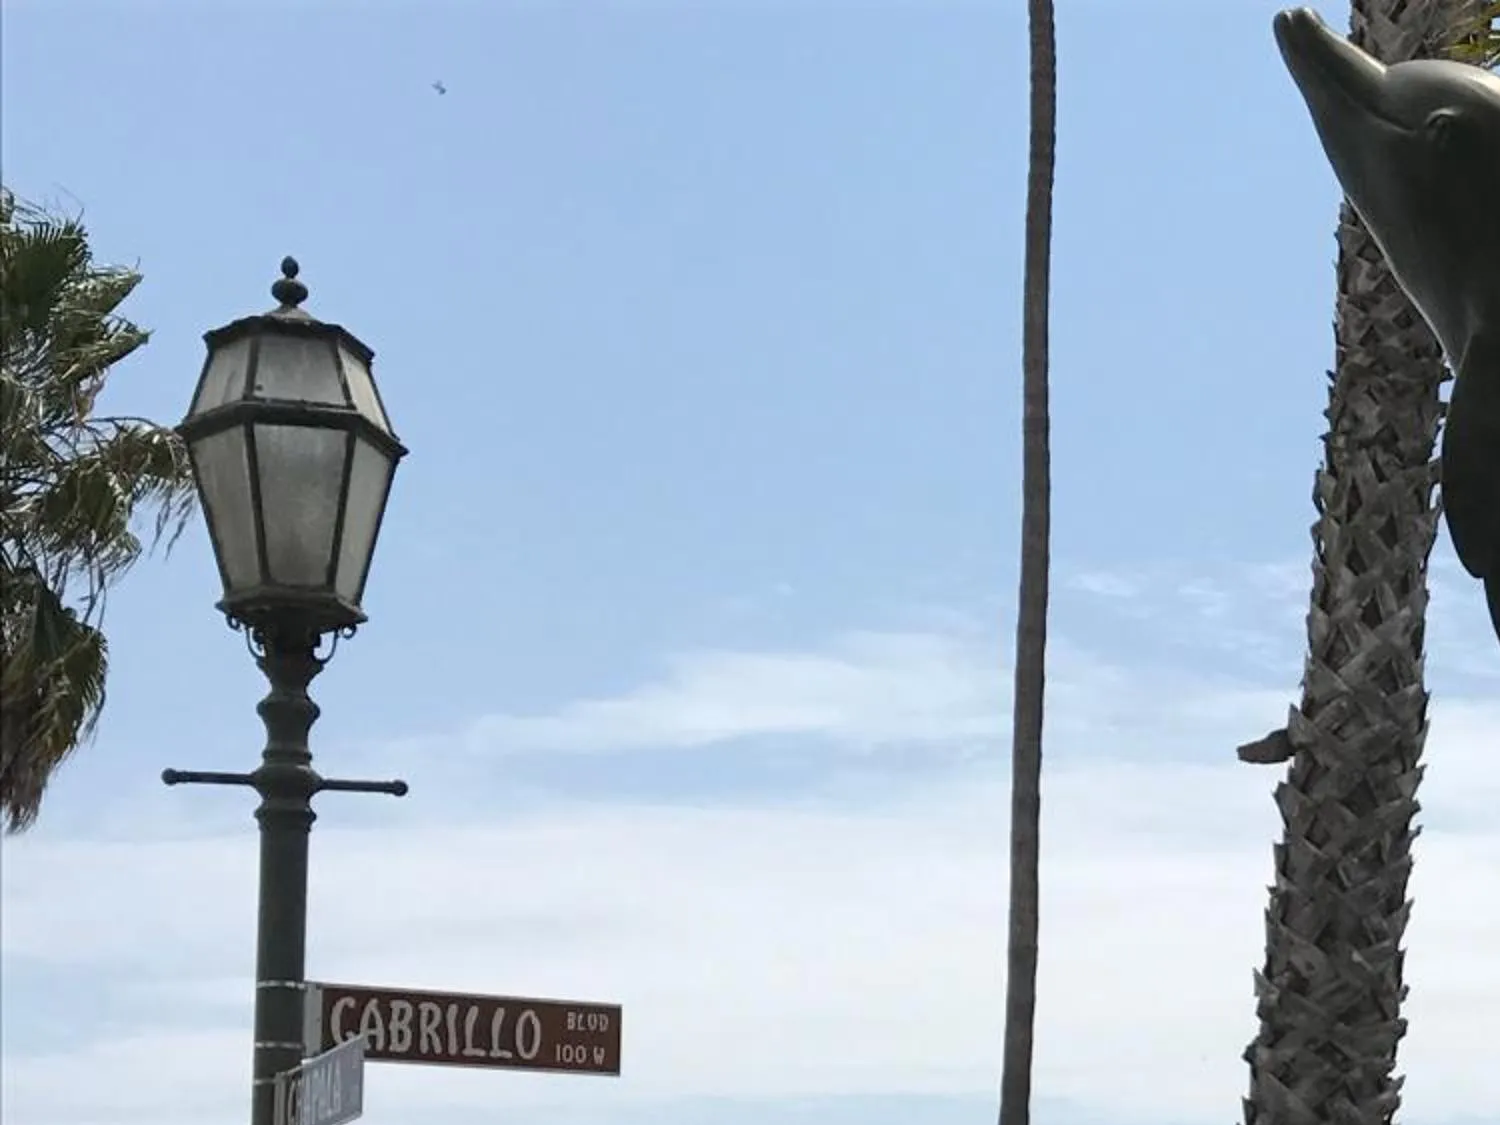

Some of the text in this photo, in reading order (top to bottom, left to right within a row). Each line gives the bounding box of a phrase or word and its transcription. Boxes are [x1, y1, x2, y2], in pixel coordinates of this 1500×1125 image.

[330, 996, 542, 1061] CABRILLO
[555, 1043, 605, 1065] 100 W
